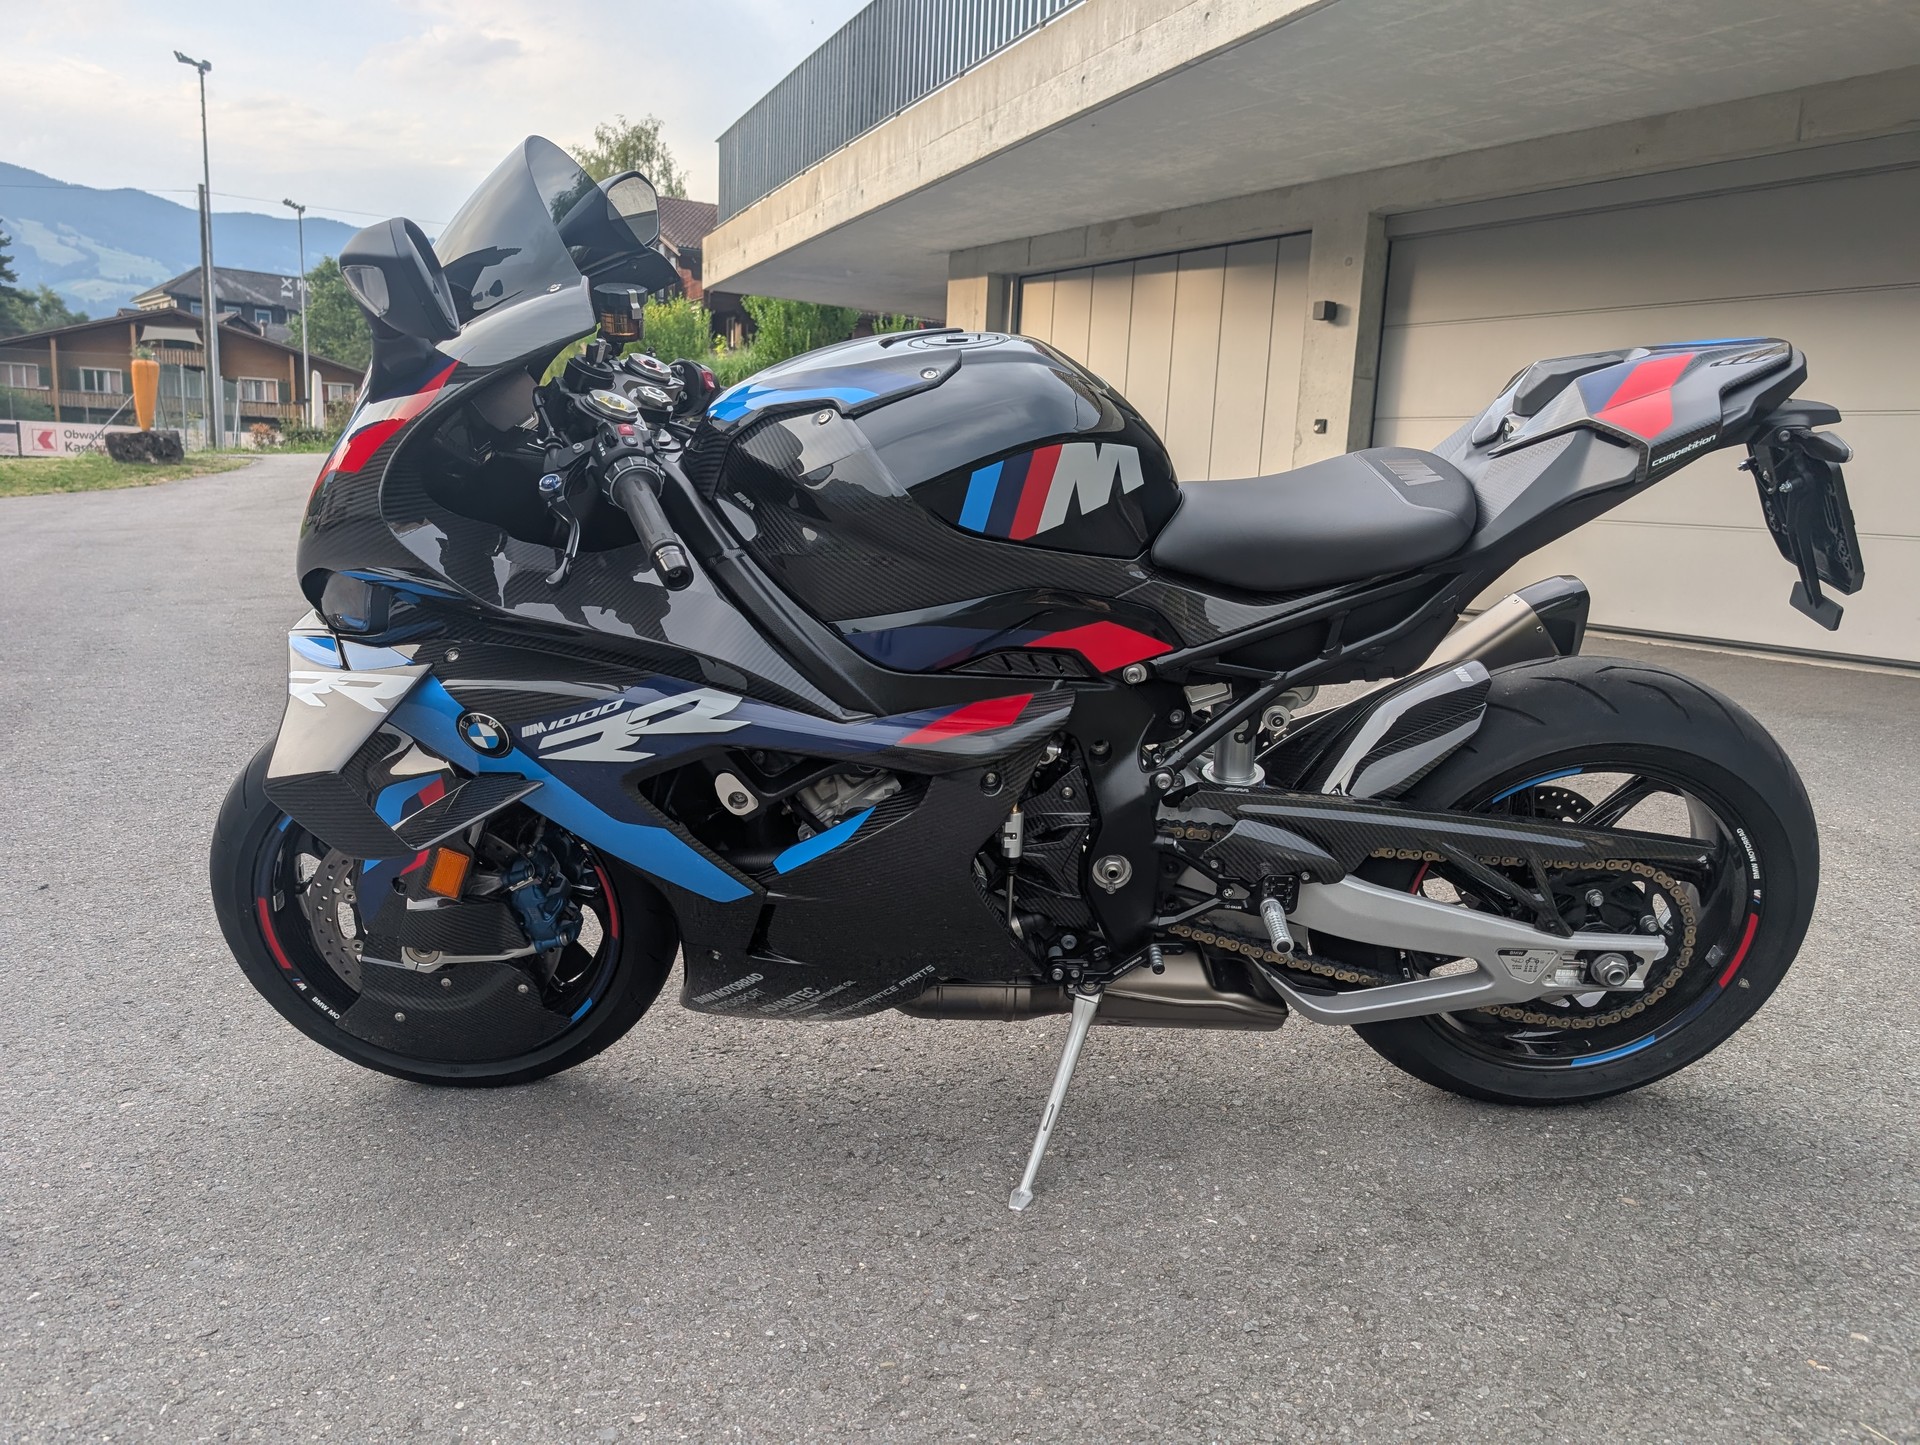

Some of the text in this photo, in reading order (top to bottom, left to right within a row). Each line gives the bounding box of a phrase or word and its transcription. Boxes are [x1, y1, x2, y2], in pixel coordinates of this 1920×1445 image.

[64, 430, 105, 440] Obwald
[1652, 434, 1716, 466] competition
[1034, 442, 1144, 535] M
[289, 671, 417, 713] RR
[460, 715, 499, 730] BMW
[538, 687, 751, 762] RR
[1736, 827, 1760, 880] BMW MOTORRAD
[692, 973, 764, 1005] BMW MOTORRAD
[758, 987, 820, 1013] ADVANTEC
[830, 985, 899, 1015] PERFORMANCE
[899, 964, 936, 988] PARTS
[312, 996, 340, 1020] BMW MO
